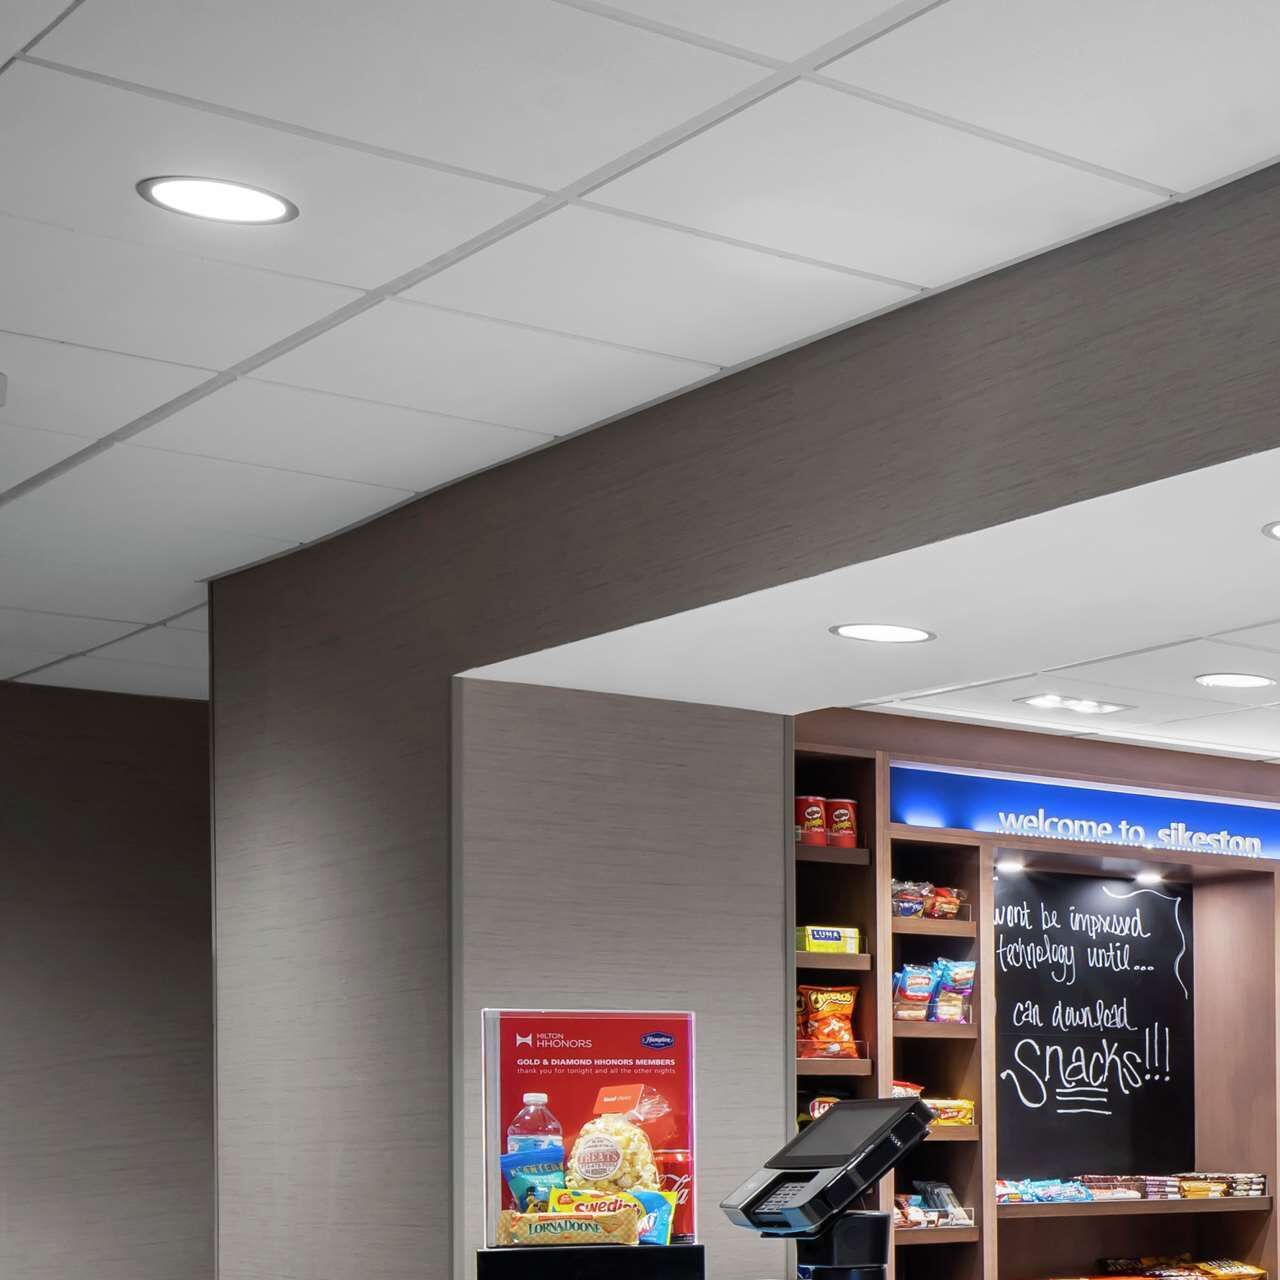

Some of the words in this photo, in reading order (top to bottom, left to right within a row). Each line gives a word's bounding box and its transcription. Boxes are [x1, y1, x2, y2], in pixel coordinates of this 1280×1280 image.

[998, 808, 1113, 837] welcome
[1118, 820, 1145, 842] to
[1157, 822, 1262, 854] sikeston
[1040, 902, 1061, 930] be
[1069, 906, 1151, 939] impressed
[813, 929, 840, 940] LUNA
[996, 934, 1076, 986] technology
[810, 991, 854, 1010] Cheetos
[1013, 1000, 1044, 1027] can
[1052, 998, 1138, 1032] download
[536, 1039, 593, 1048] HHONORS
[567, 1067, 593, 1075] tonight
[654, 1067, 676, 1075] nights
